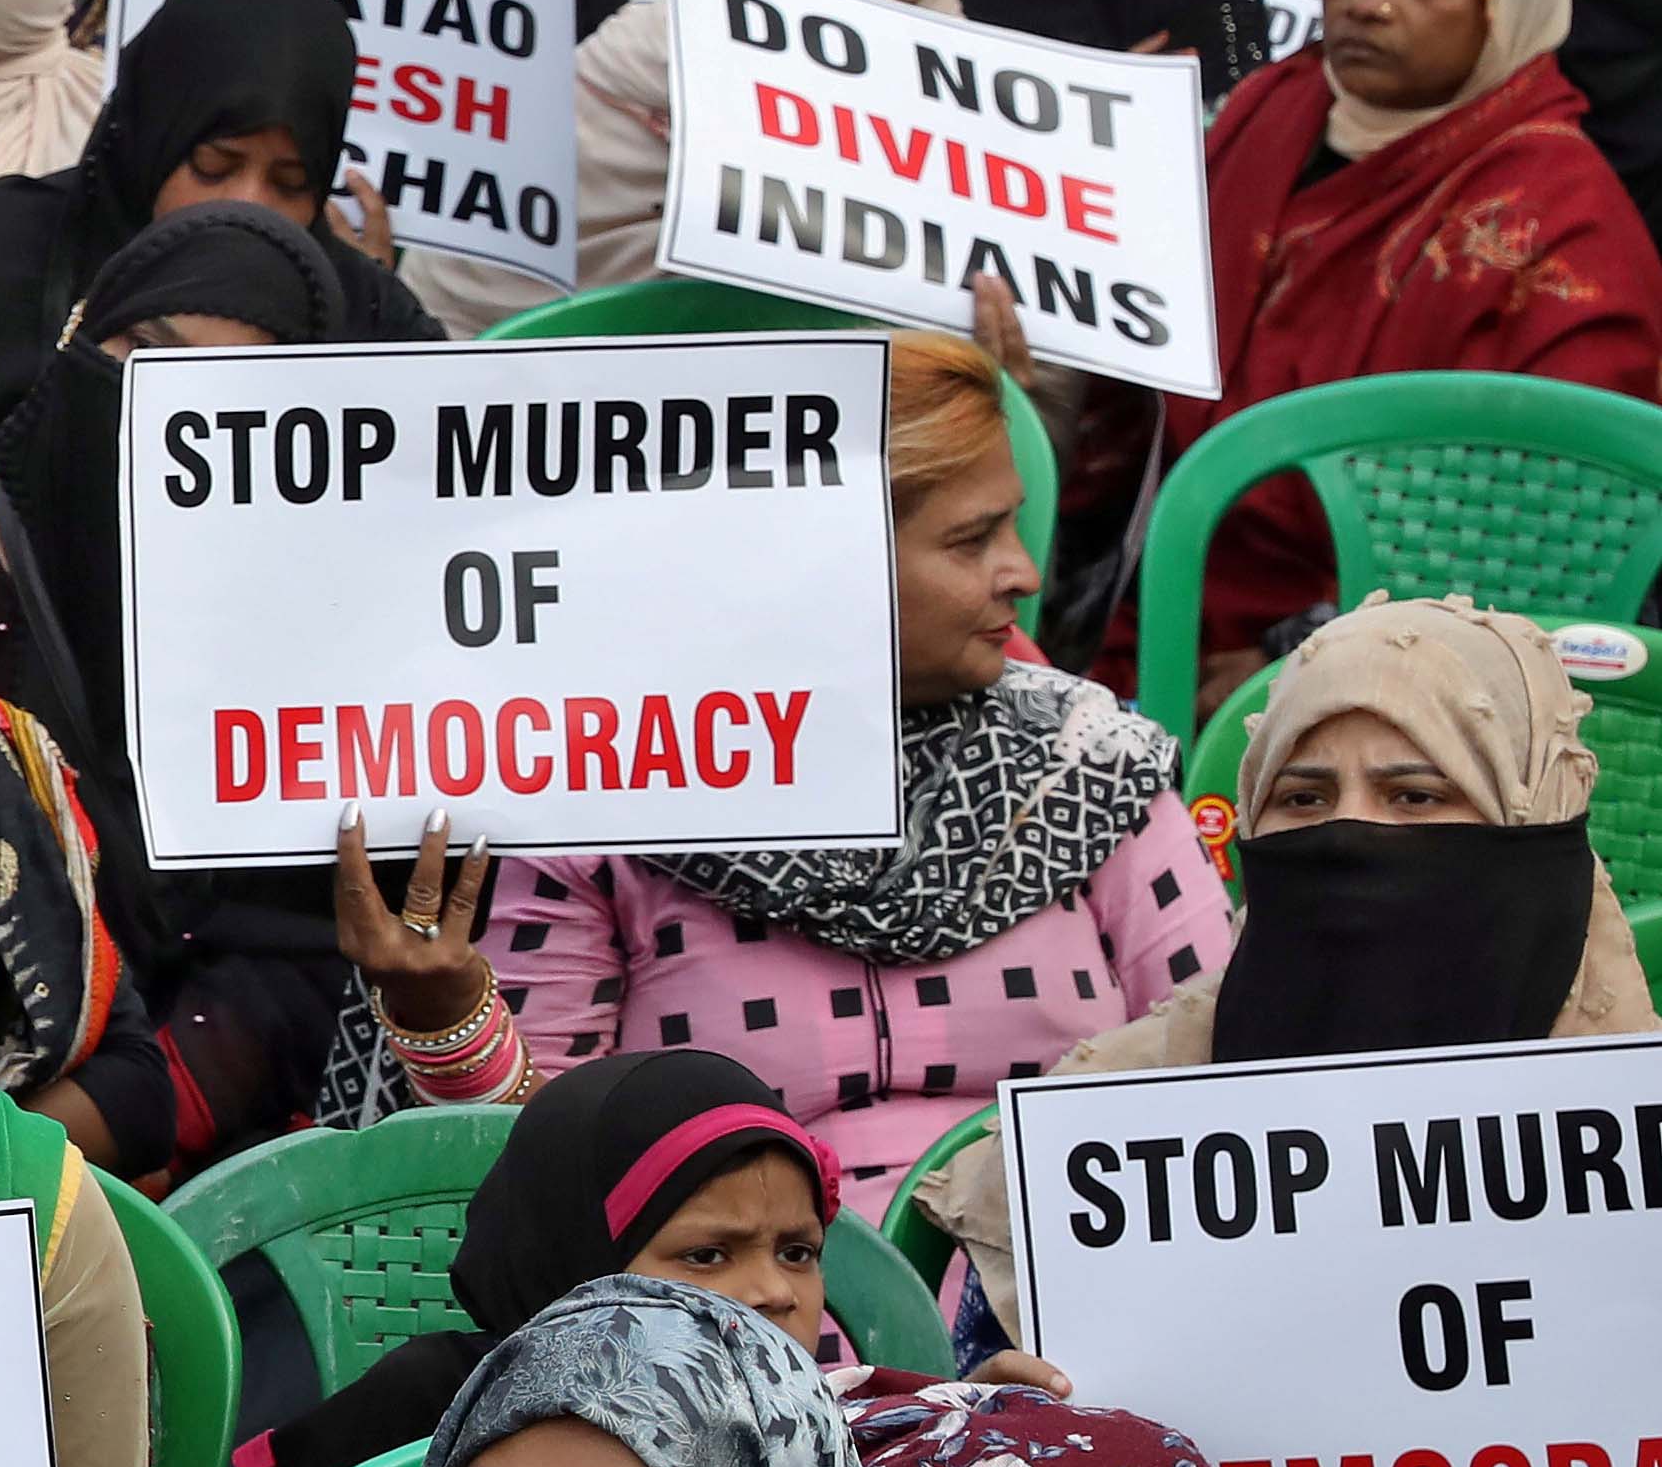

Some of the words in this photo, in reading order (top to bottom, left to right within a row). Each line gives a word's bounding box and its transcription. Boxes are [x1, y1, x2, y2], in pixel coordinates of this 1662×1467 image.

[914, 43, 1134, 152] NOT
[753, 80, 1122, 245] DIVIDE
[715, 164, 1172, 349] INDIANS
[161, 403, 399, 511] STOP
[434, 392, 844, 501] MURDER
[442, 547, 561, 650] OF
[213, 686, 814, 805] DEMOCRACY
[1066, 1126, 1332, 1250] STOP
[1398, 1277, 1536, 1395] OF
